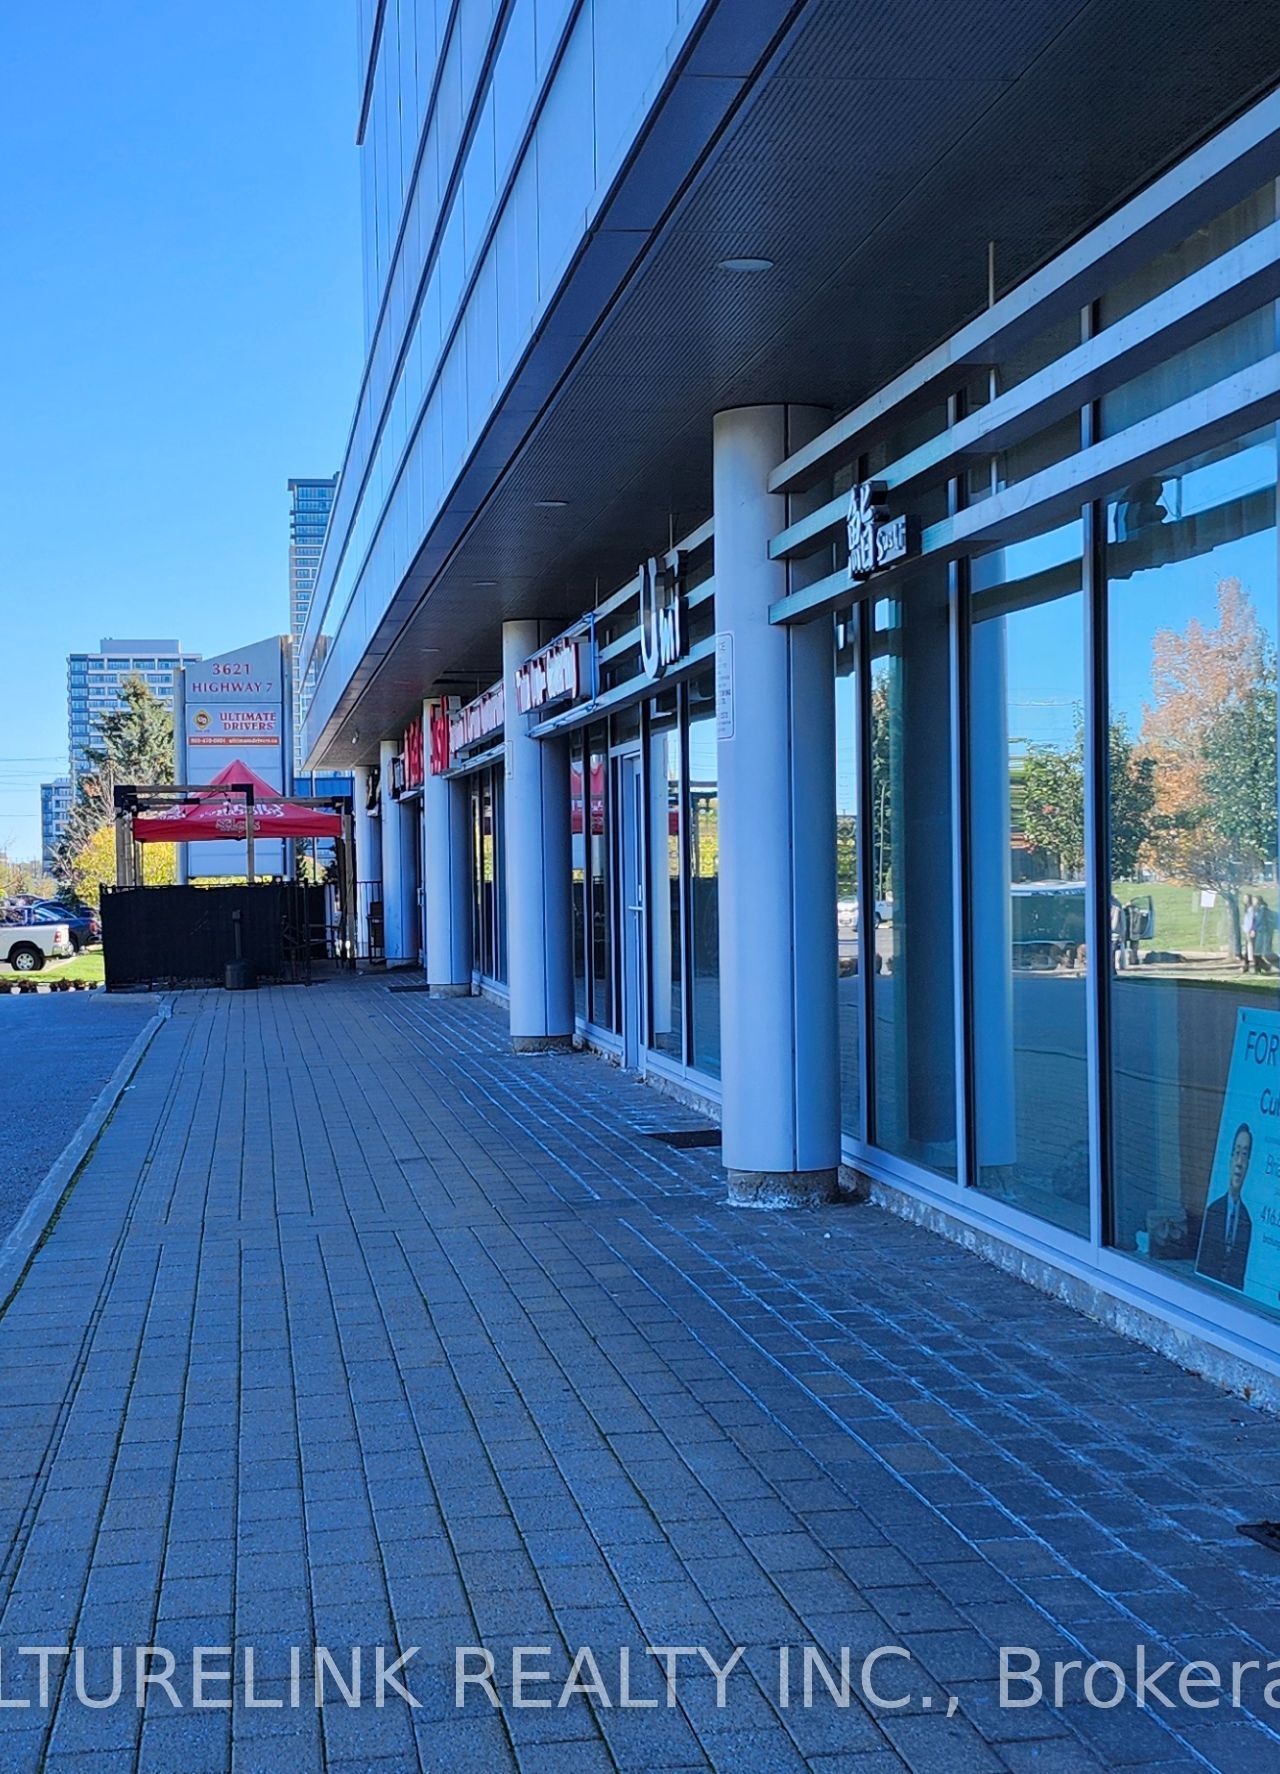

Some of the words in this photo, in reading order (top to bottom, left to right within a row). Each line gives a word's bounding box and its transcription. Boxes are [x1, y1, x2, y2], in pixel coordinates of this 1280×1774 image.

[212, 663, 251, 676] 3621
[192, 682, 261, 693] HIGHWAY
[266, 682, 273, 693] 7
[220, 712, 277, 722] ULTIMATE
[223, 722, 274, 731] DRIVERS
[1244, 1030, 1280, 1067] FOR
